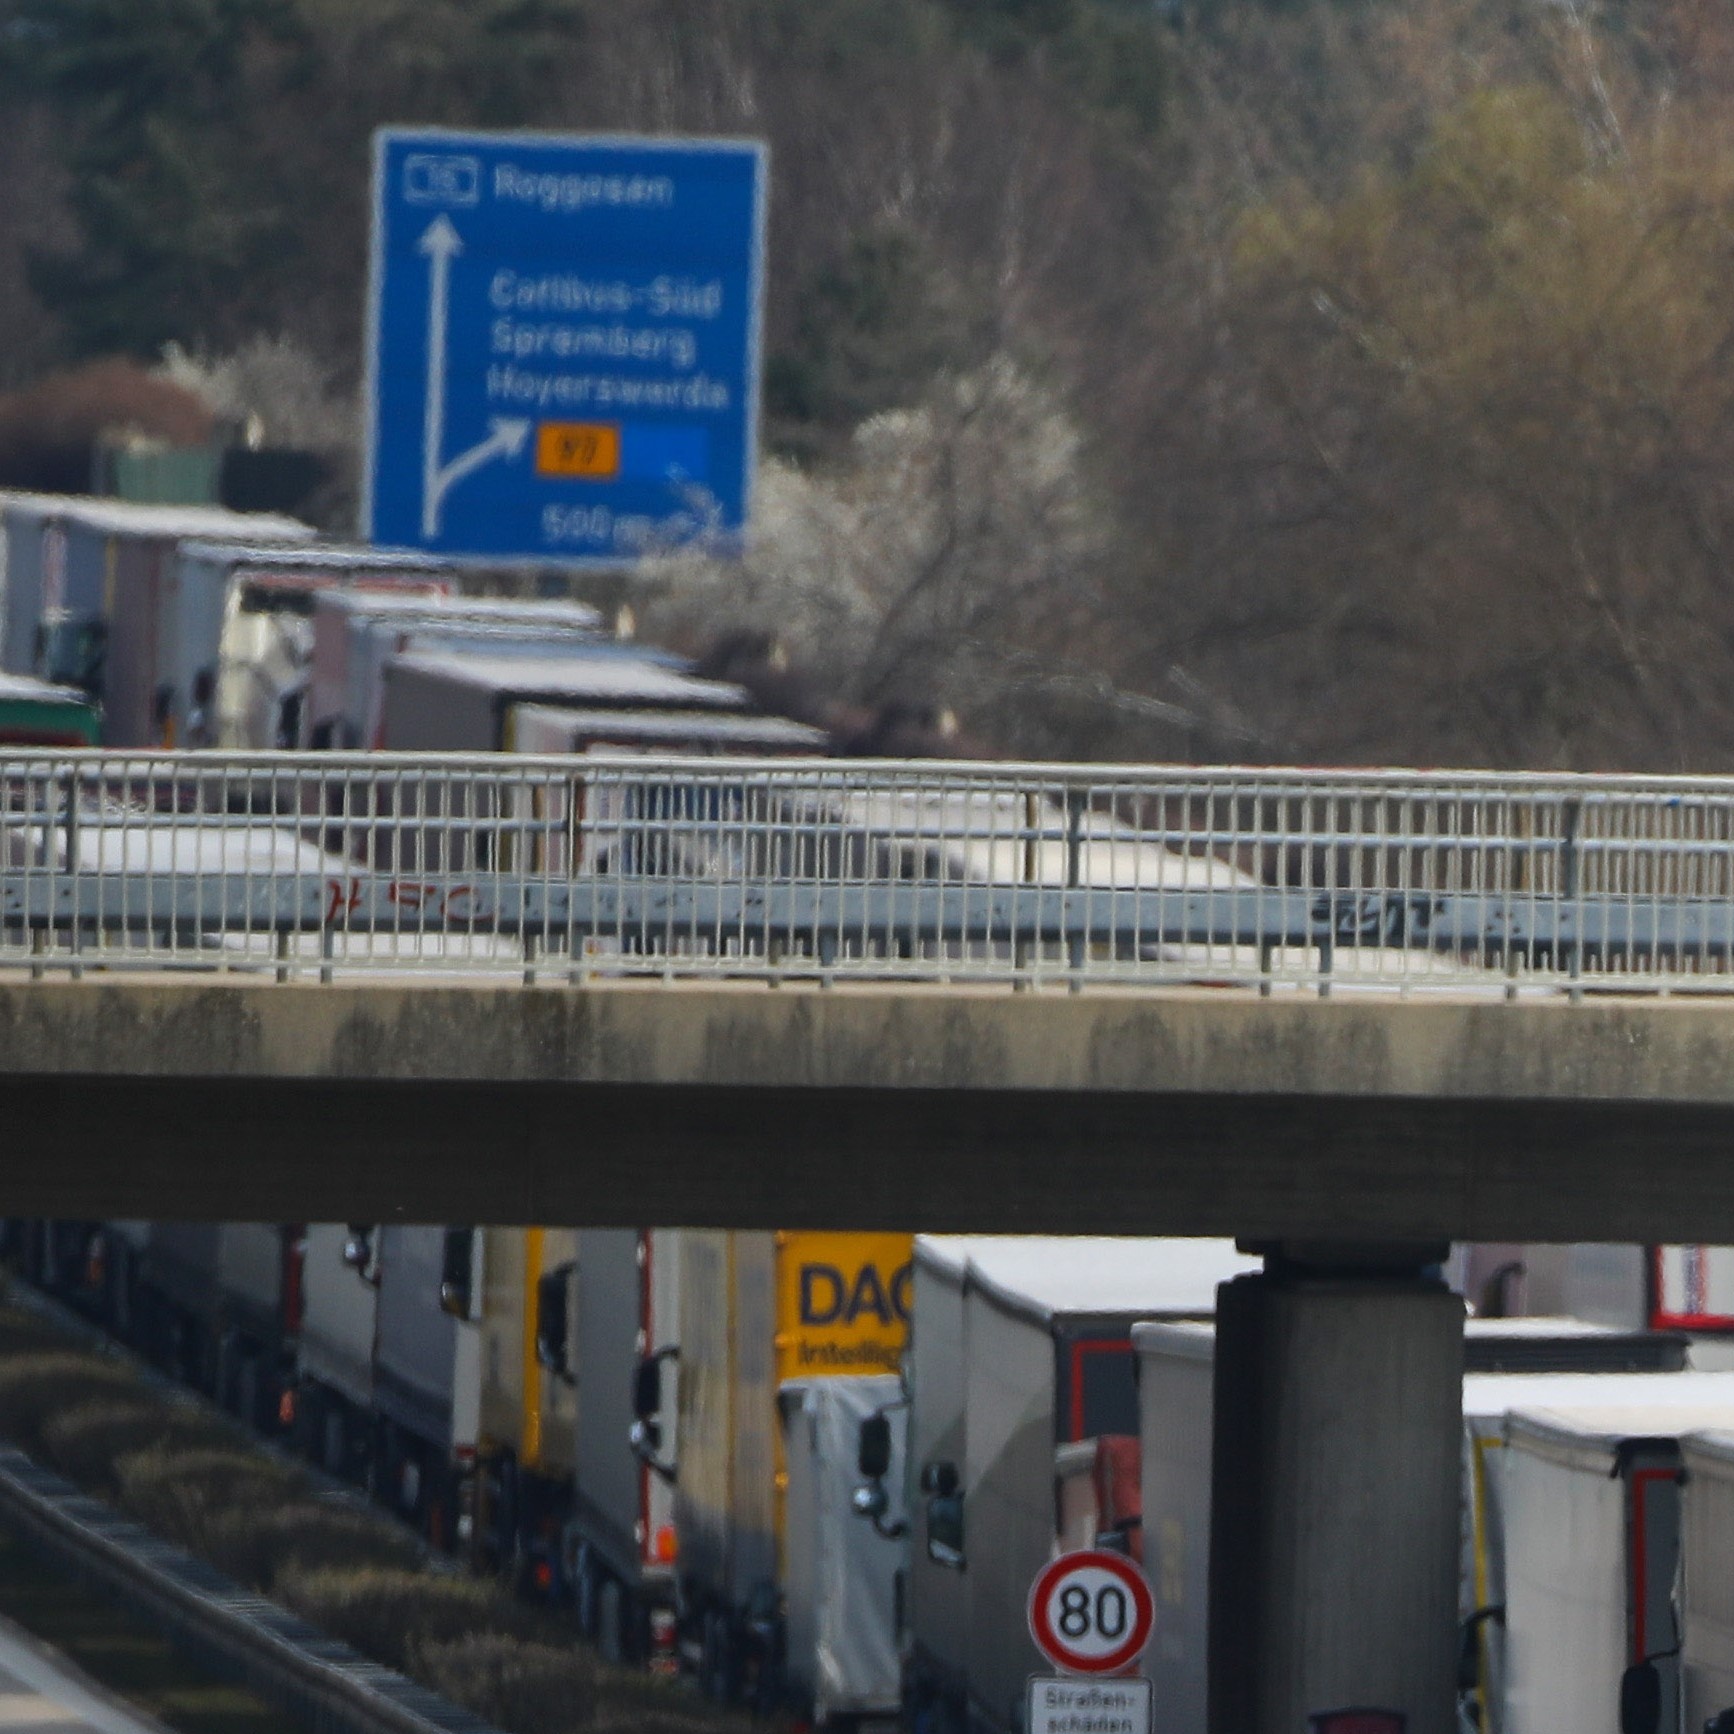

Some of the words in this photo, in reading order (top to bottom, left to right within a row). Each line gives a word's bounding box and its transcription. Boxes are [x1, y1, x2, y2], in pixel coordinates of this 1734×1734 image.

[489, 269, 723, 320] Cottbus-Süd
[492, 315, 697, 369] Spremberg
[485, 363, 729, 412] Hoyerswerda
[541, 502, 613, 544] 500
[1059, 1585, 1127, 1638] 80
[1045, 1685, 1136, 1711] Straßen-
